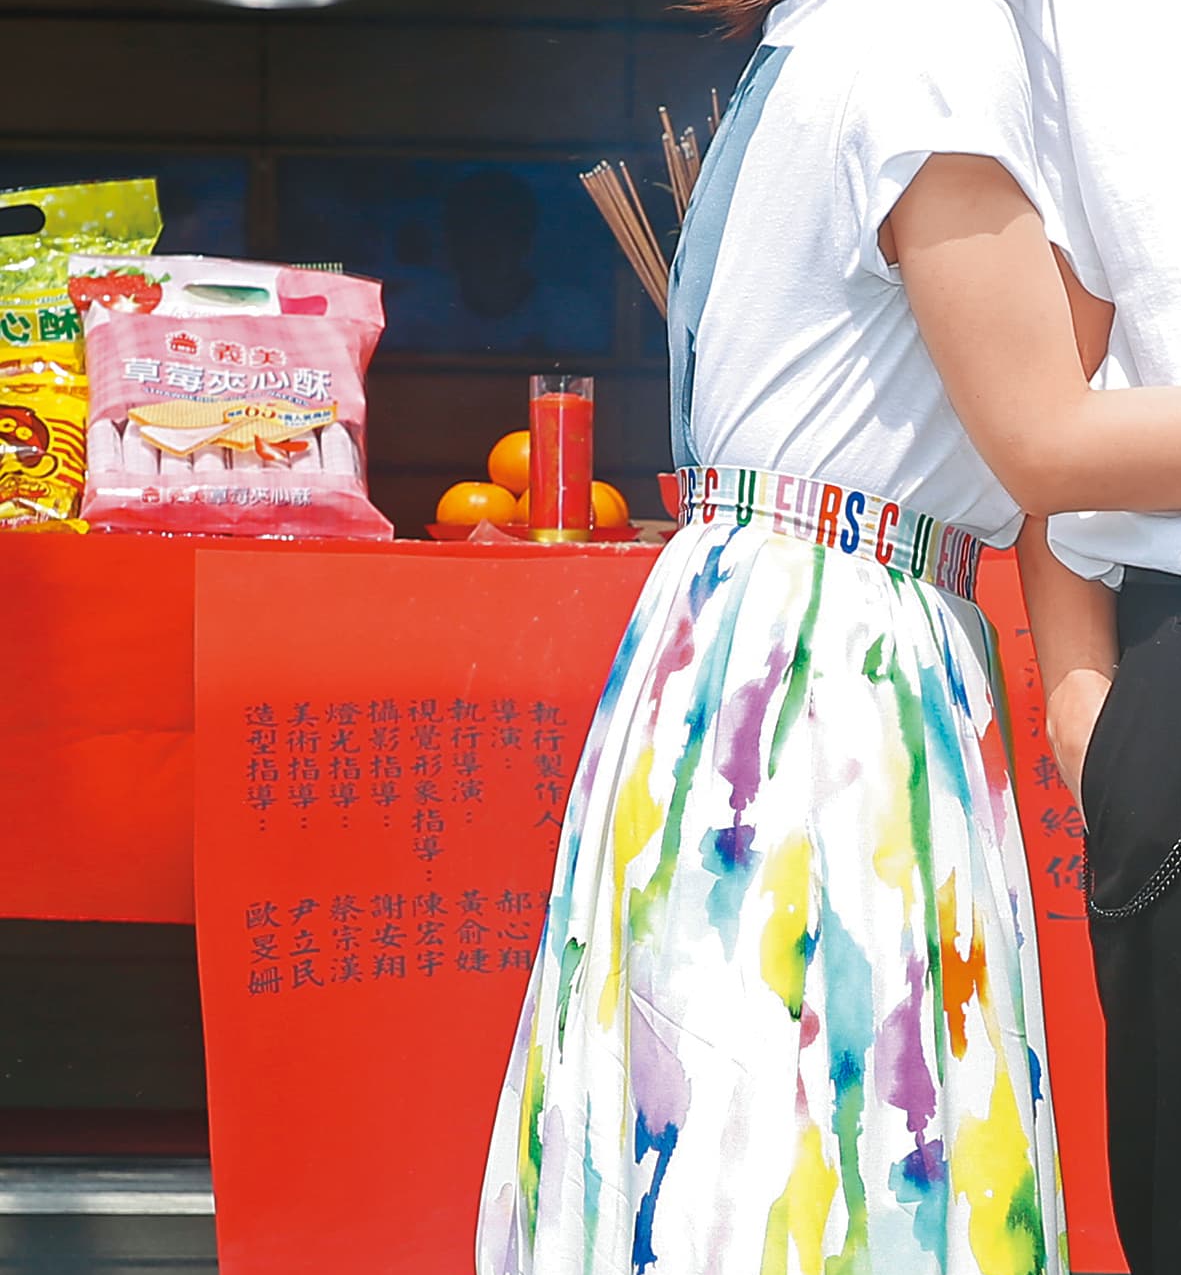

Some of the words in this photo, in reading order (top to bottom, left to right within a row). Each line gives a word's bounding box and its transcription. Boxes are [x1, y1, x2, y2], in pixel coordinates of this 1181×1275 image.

[122, 357, 332, 401] 草莓夾心酥
[288, 898, 324, 989] 尹立民
[330, 895, 365, 983] 蔡宗漢
[370, 894, 407, 979] 謝安翔
[412, 892, 448, 977] 陳宏宇
[496, 889, 533, 971] 郝心翔
